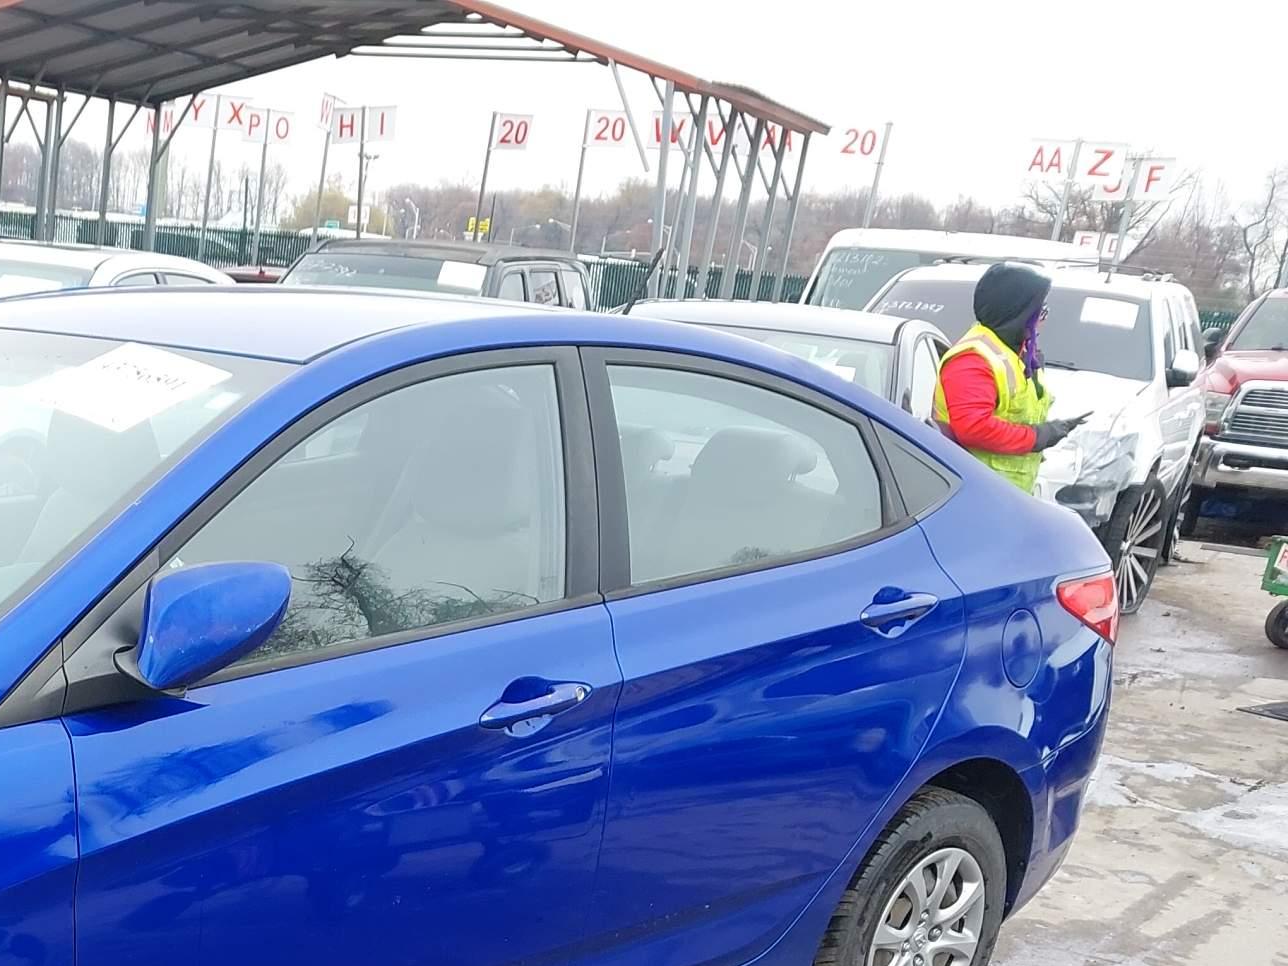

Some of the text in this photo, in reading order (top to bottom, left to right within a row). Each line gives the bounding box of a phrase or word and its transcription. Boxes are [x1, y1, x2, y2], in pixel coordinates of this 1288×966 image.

[192, 98, 206, 121] Y
[227, 101, 245, 125] X
[249, 113, 261, 136] P
[339, 112, 355, 138] H
[499, 119, 529, 144] 20
[594, 116, 626, 142] 20
[840, 128, 877, 156] 20
[1027, 145, 1062, 173] AA
[1087, 149, 1115, 177] Z
[1144, 165, 1166, 193] F
